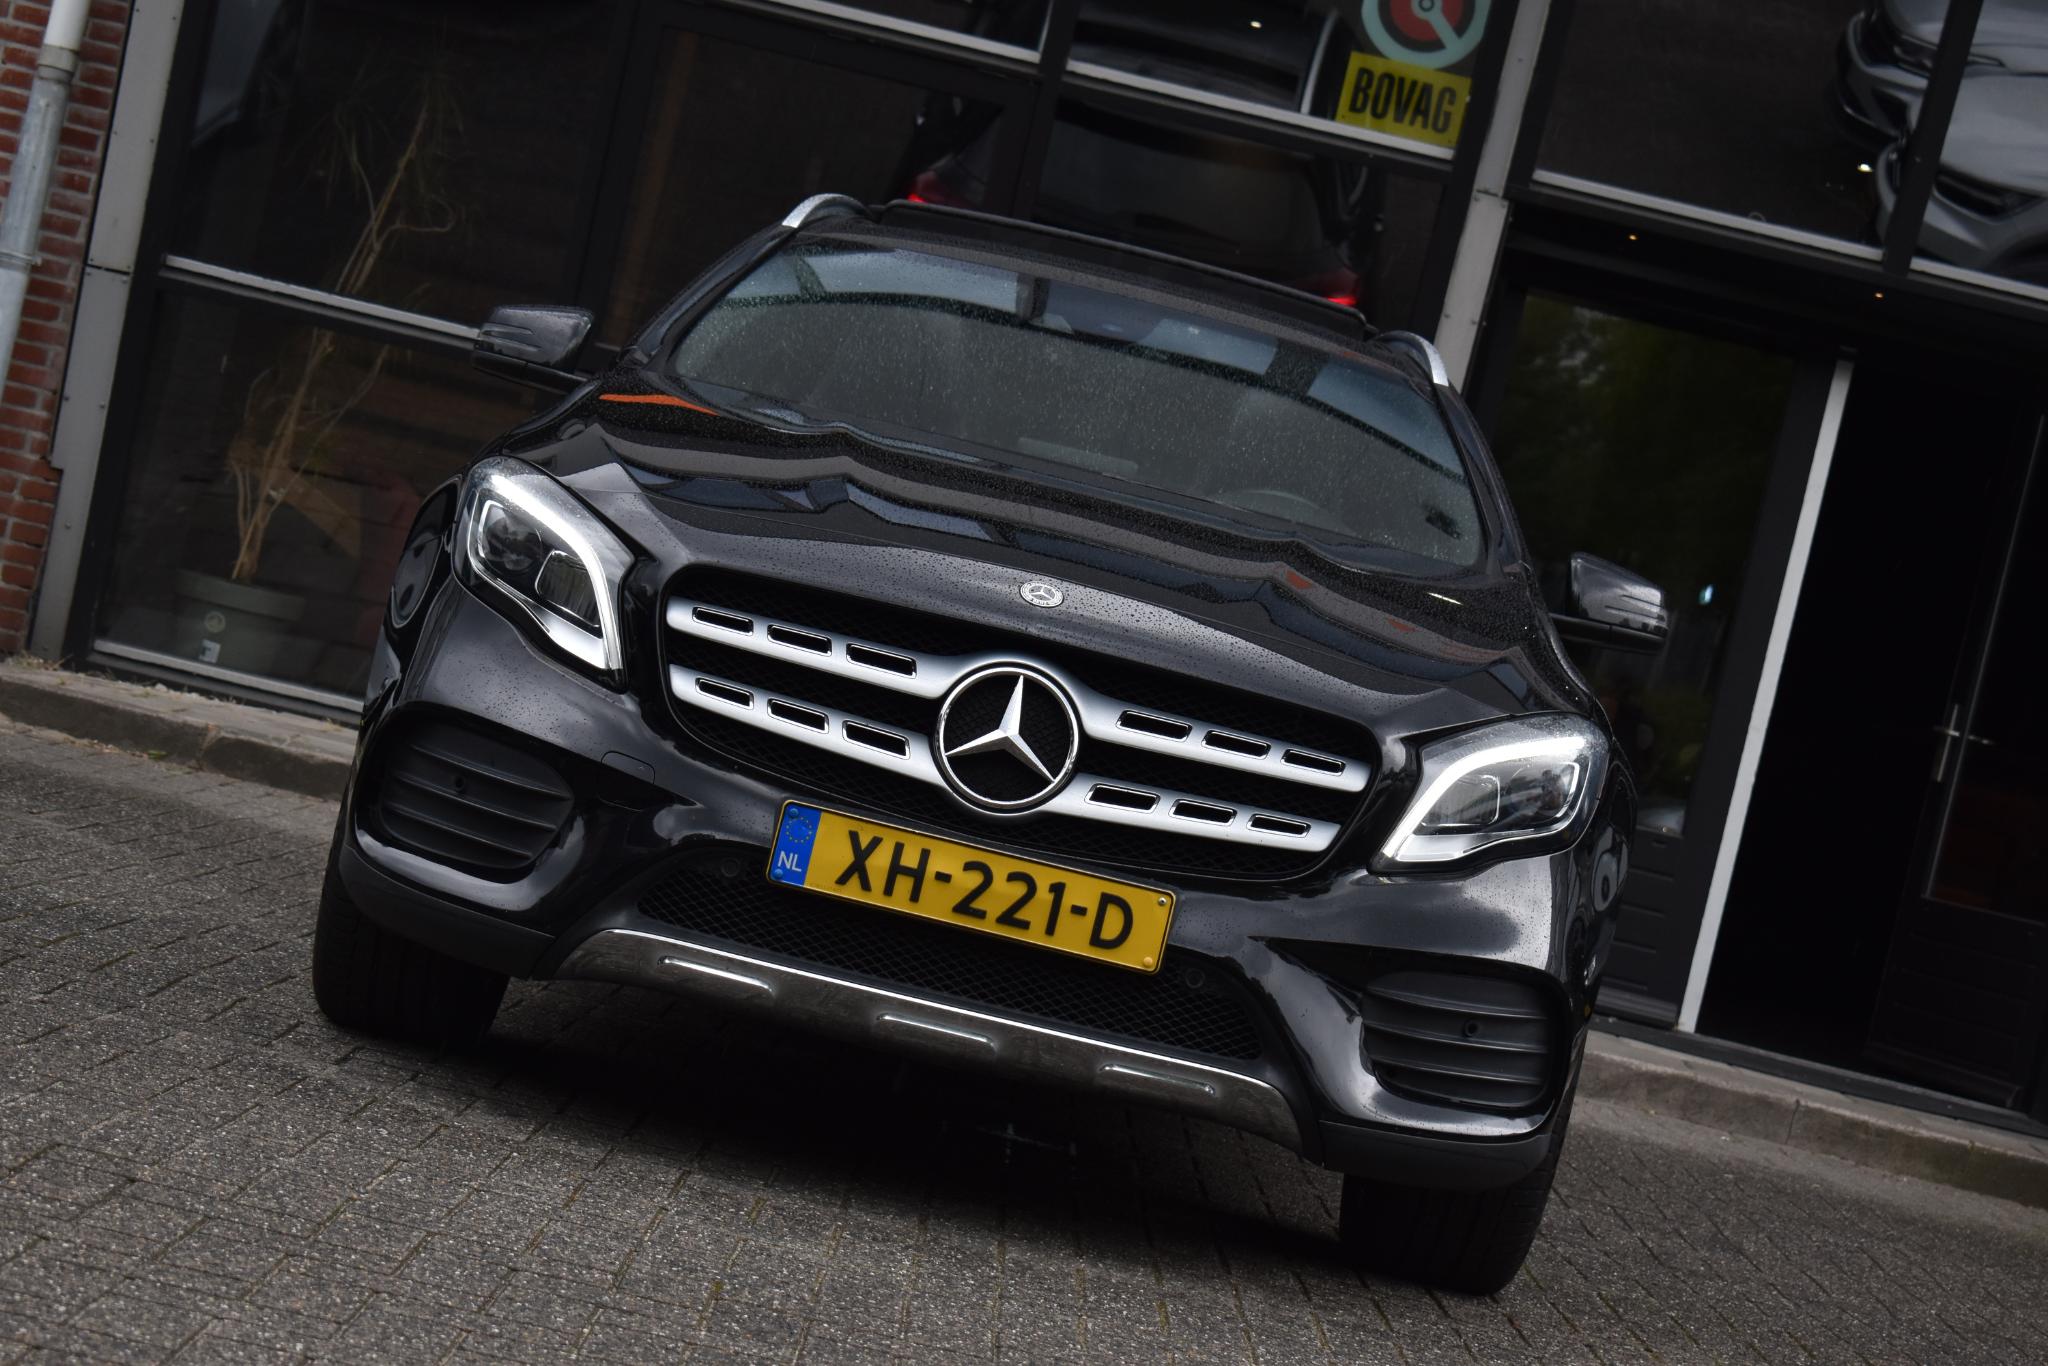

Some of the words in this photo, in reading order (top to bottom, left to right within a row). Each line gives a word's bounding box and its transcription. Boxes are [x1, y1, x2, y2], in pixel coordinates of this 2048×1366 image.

[1349, 67, 1457, 134] BOVAG
[778, 850, 802, 872] NL
[835, 829, 1134, 949] XH-221-D
